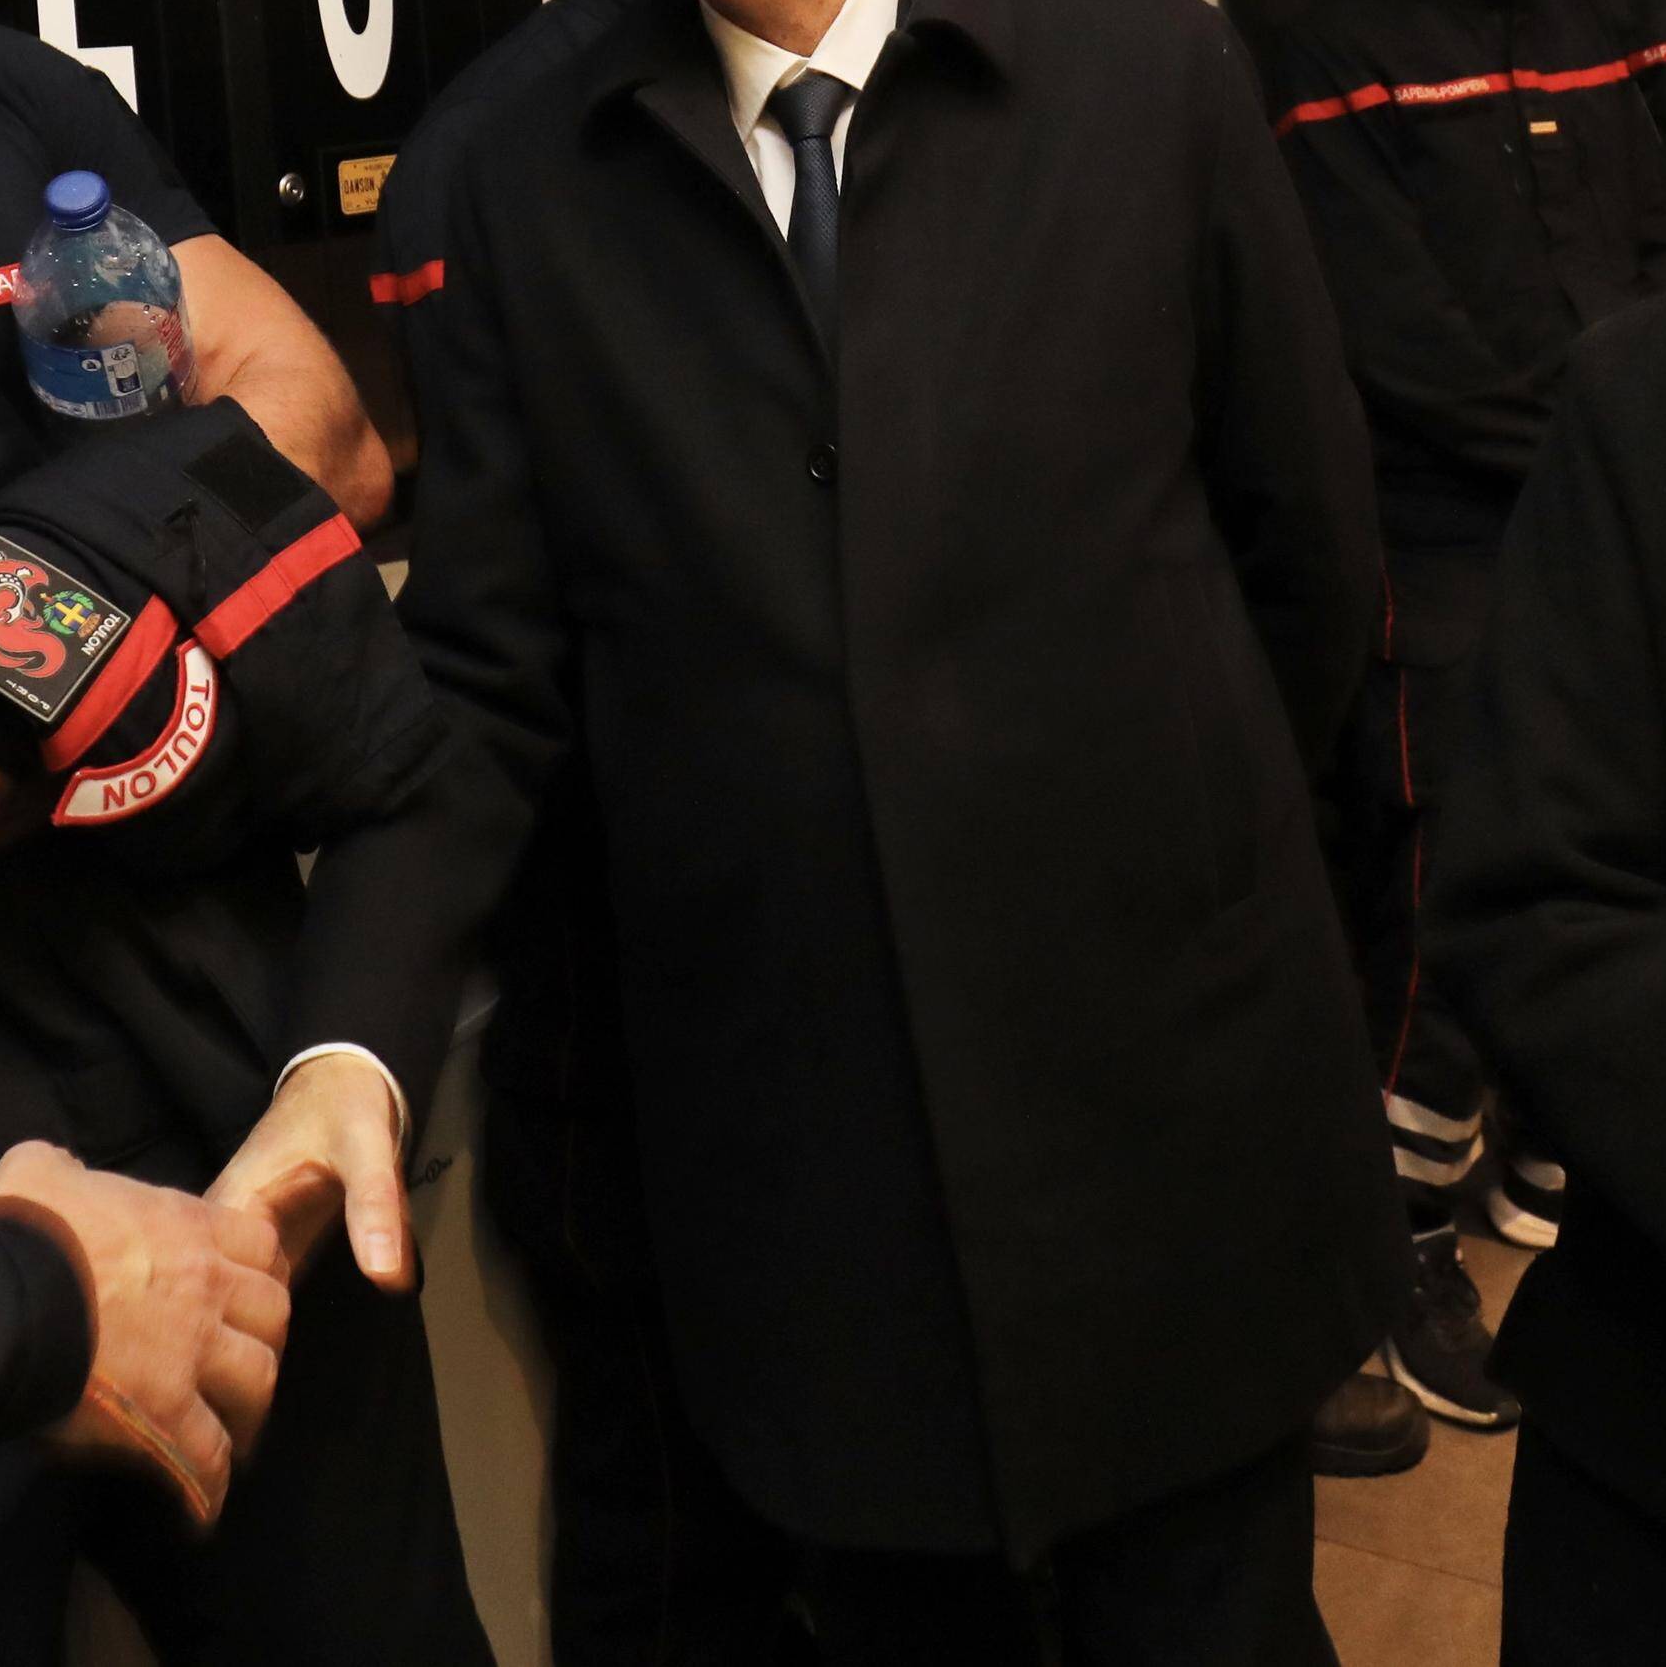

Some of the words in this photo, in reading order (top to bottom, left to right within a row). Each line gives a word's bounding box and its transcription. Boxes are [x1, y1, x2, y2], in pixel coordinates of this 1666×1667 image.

[81, 612, 121, 656] TOULON
[5, 678, 51, 711] PORT
[102, 679, 210, 812] TOULON
